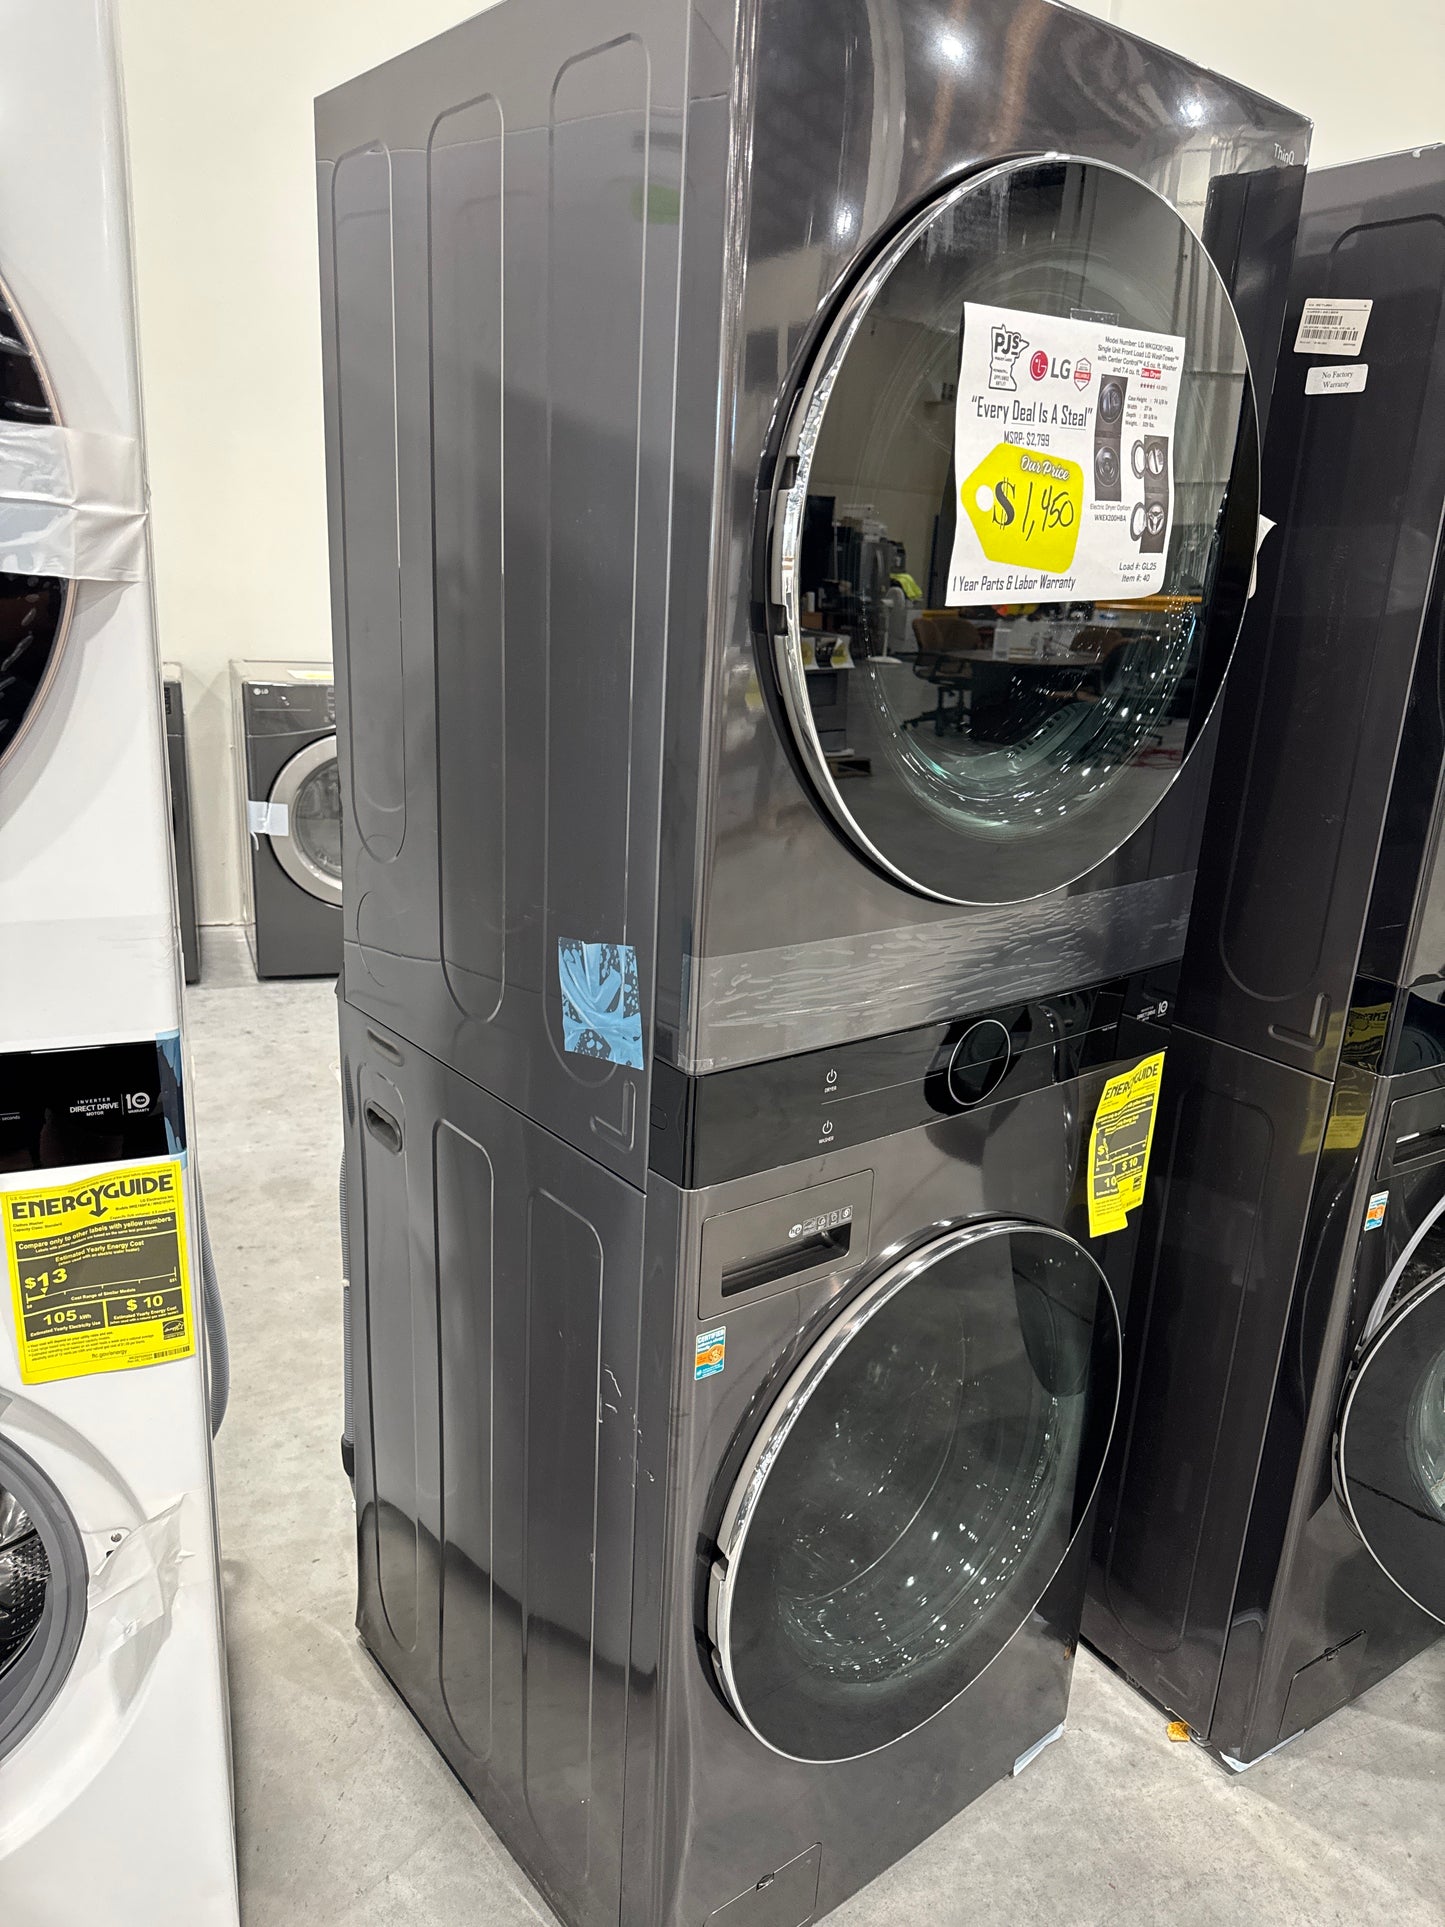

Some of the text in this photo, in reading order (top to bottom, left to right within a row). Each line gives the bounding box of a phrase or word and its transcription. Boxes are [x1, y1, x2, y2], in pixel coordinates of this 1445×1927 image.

[1274, 143, 1295, 165] ThinQ
[1105, 336, 1118, 344] Model
[1097, 344, 1111, 354] Single
[1112, 346, 1121, 354] Unit
[1122, 348, 1133, 356] Front
[1133, 350, 1144, 358] Load
[1108, 355, 1122, 364] Center
[1050, 357, 1071, 380] LG
[1321, 370, 1354, 379] No Factory
[1012, 400, 1036, 422] Deal
[1038, 402, 1048, 423] Is
[1051, 404, 1058, 424] A
[1004, 430, 1050, 447] MSRP: $2,799
[1021, 455, 1070, 481] Our Price
[992, 476, 1074, 541] $ 1,450
[1119, 562, 1134, 570] Load
[1141, 562, 1157, 570] GL25
[953, 574, 1076, 591] 1 Year Parts & Labor Warranty
[1121, 574, 1135, 582] Item
[1142, 574, 1150, 582] 40
[70, 1102, 119, 1113] DIRECT DRIVE
[126, 1092, 150, 1109] 10
[11, 1173, 173, 1220] ENERGYGUIDE
[18, 1241, 48, 1250] Compare
[50, 1238, 63, 1246] only
[72, 1230, 88, 1239] other
[89, 1225, 108, 1233] labels
[123, 1220, 143, 1228] yellow
[55, 1250, 85, 1262] Estimated
[86, 1245, 106, 1254] Yearly
[106, 1243, 129, 1251] Energy
[24, 1268, 68, 1290] $13
[126, 1295, 164, 1312] $ 10
[43, 1310, 77, 1326] 105
[30, 1328, 53, 1338] Estimated
